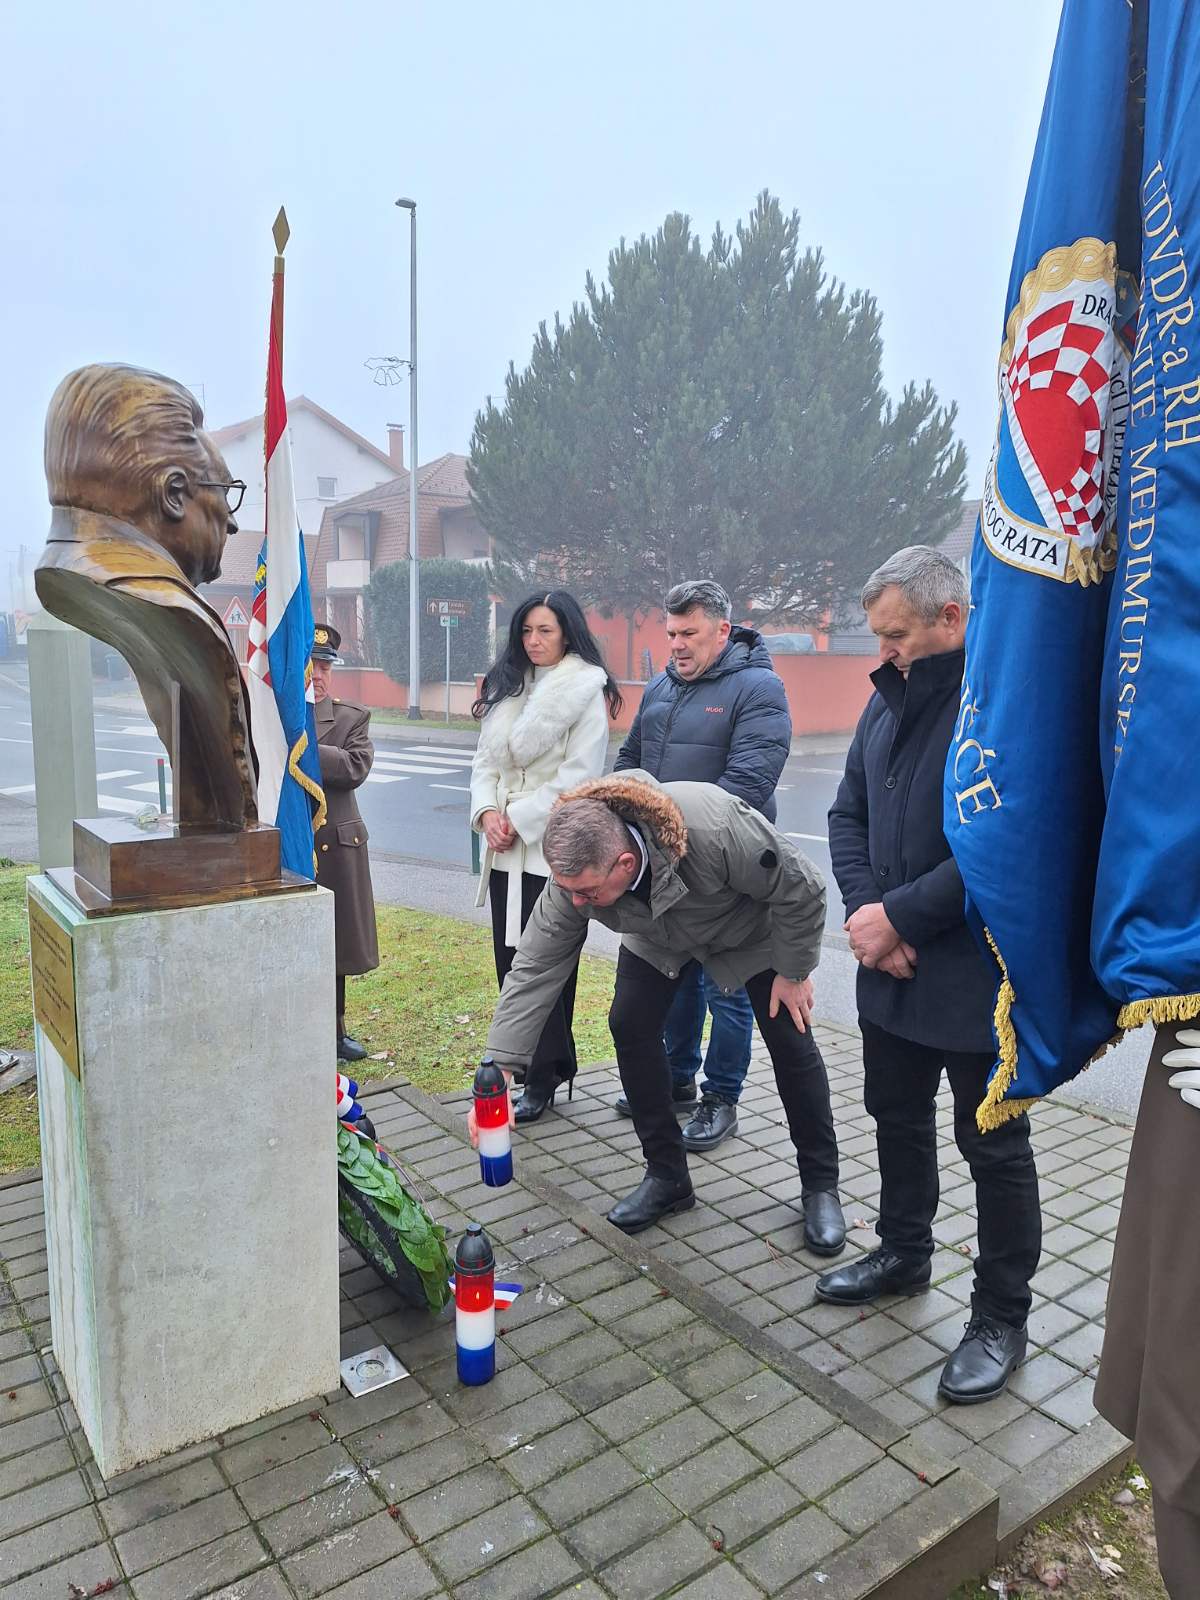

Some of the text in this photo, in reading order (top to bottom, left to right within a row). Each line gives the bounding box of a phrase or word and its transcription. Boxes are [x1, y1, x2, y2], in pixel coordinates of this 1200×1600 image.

[1142, 159, 1200, 453] UDVDR-a RH
[1000, 526, 1059, 566] RATA
